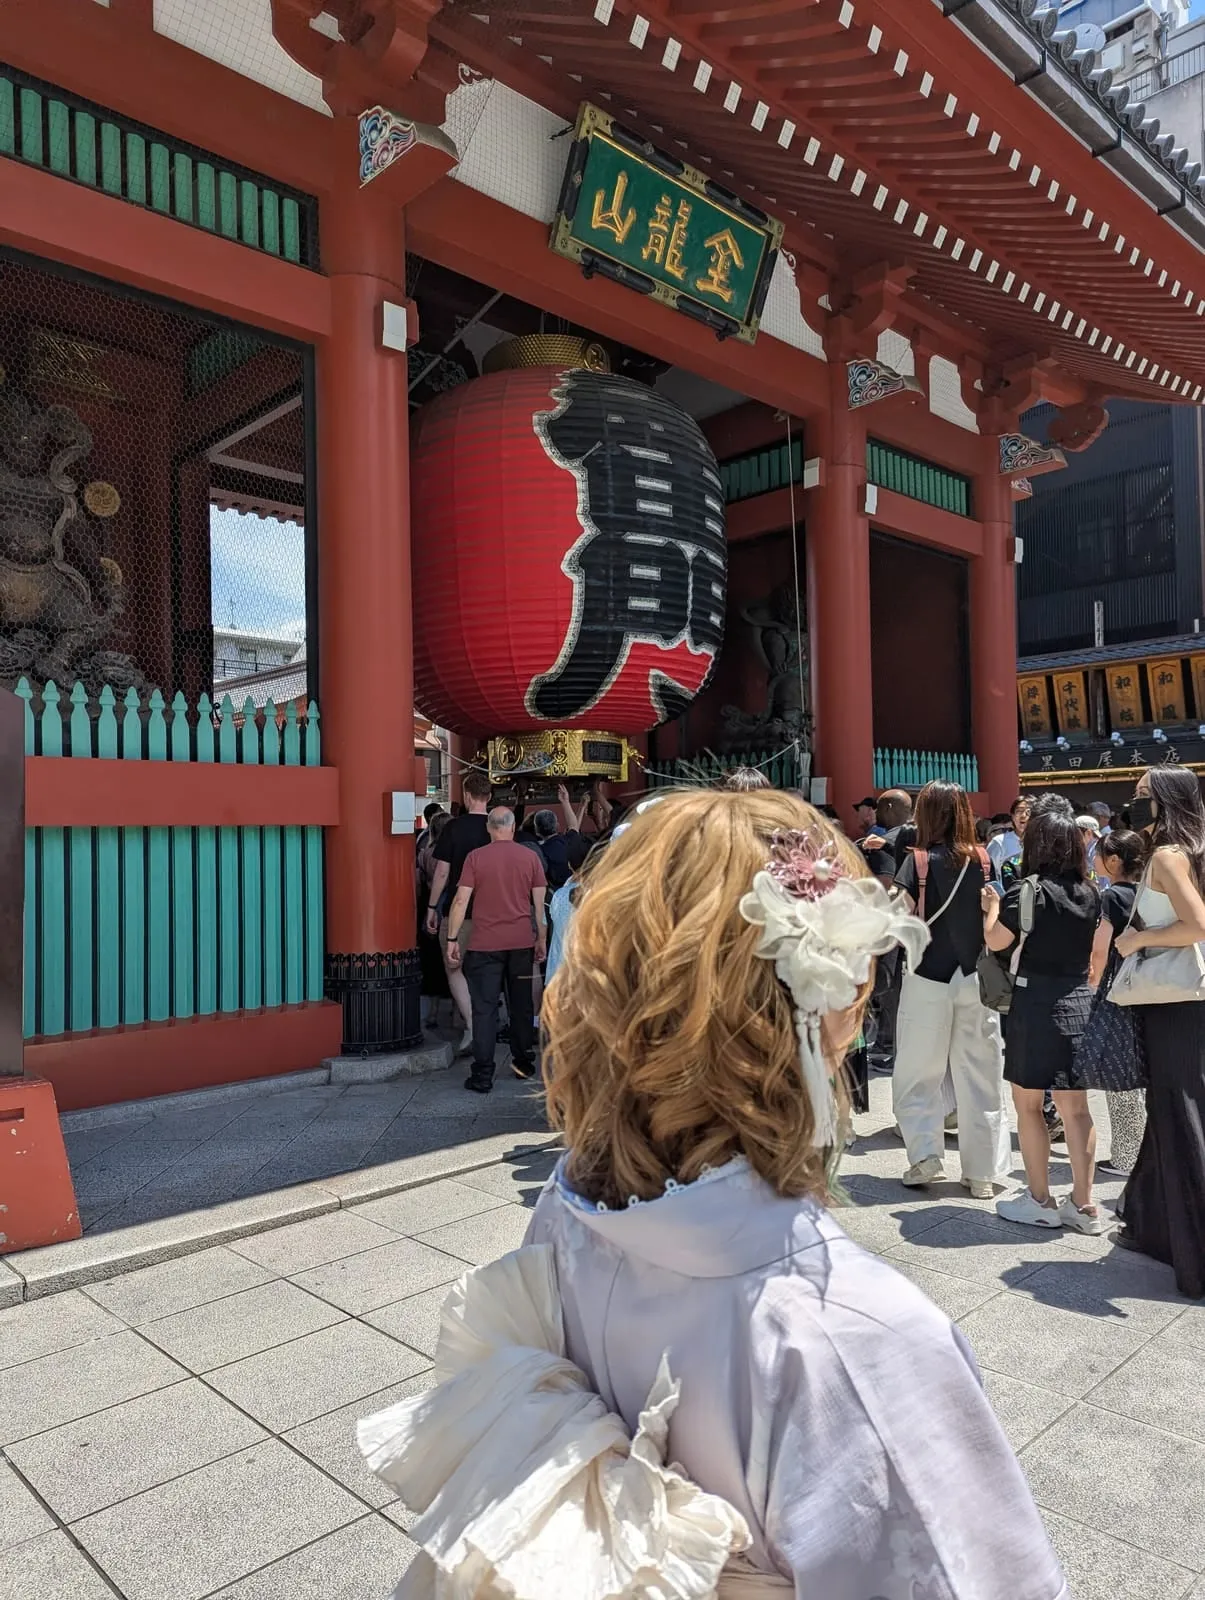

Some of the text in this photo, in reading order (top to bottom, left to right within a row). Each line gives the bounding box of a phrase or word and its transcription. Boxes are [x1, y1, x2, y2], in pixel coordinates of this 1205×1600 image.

[591, 170, 745, 303] 金龍山
[1041, 746, 1181, 770] 黒田屋本店
